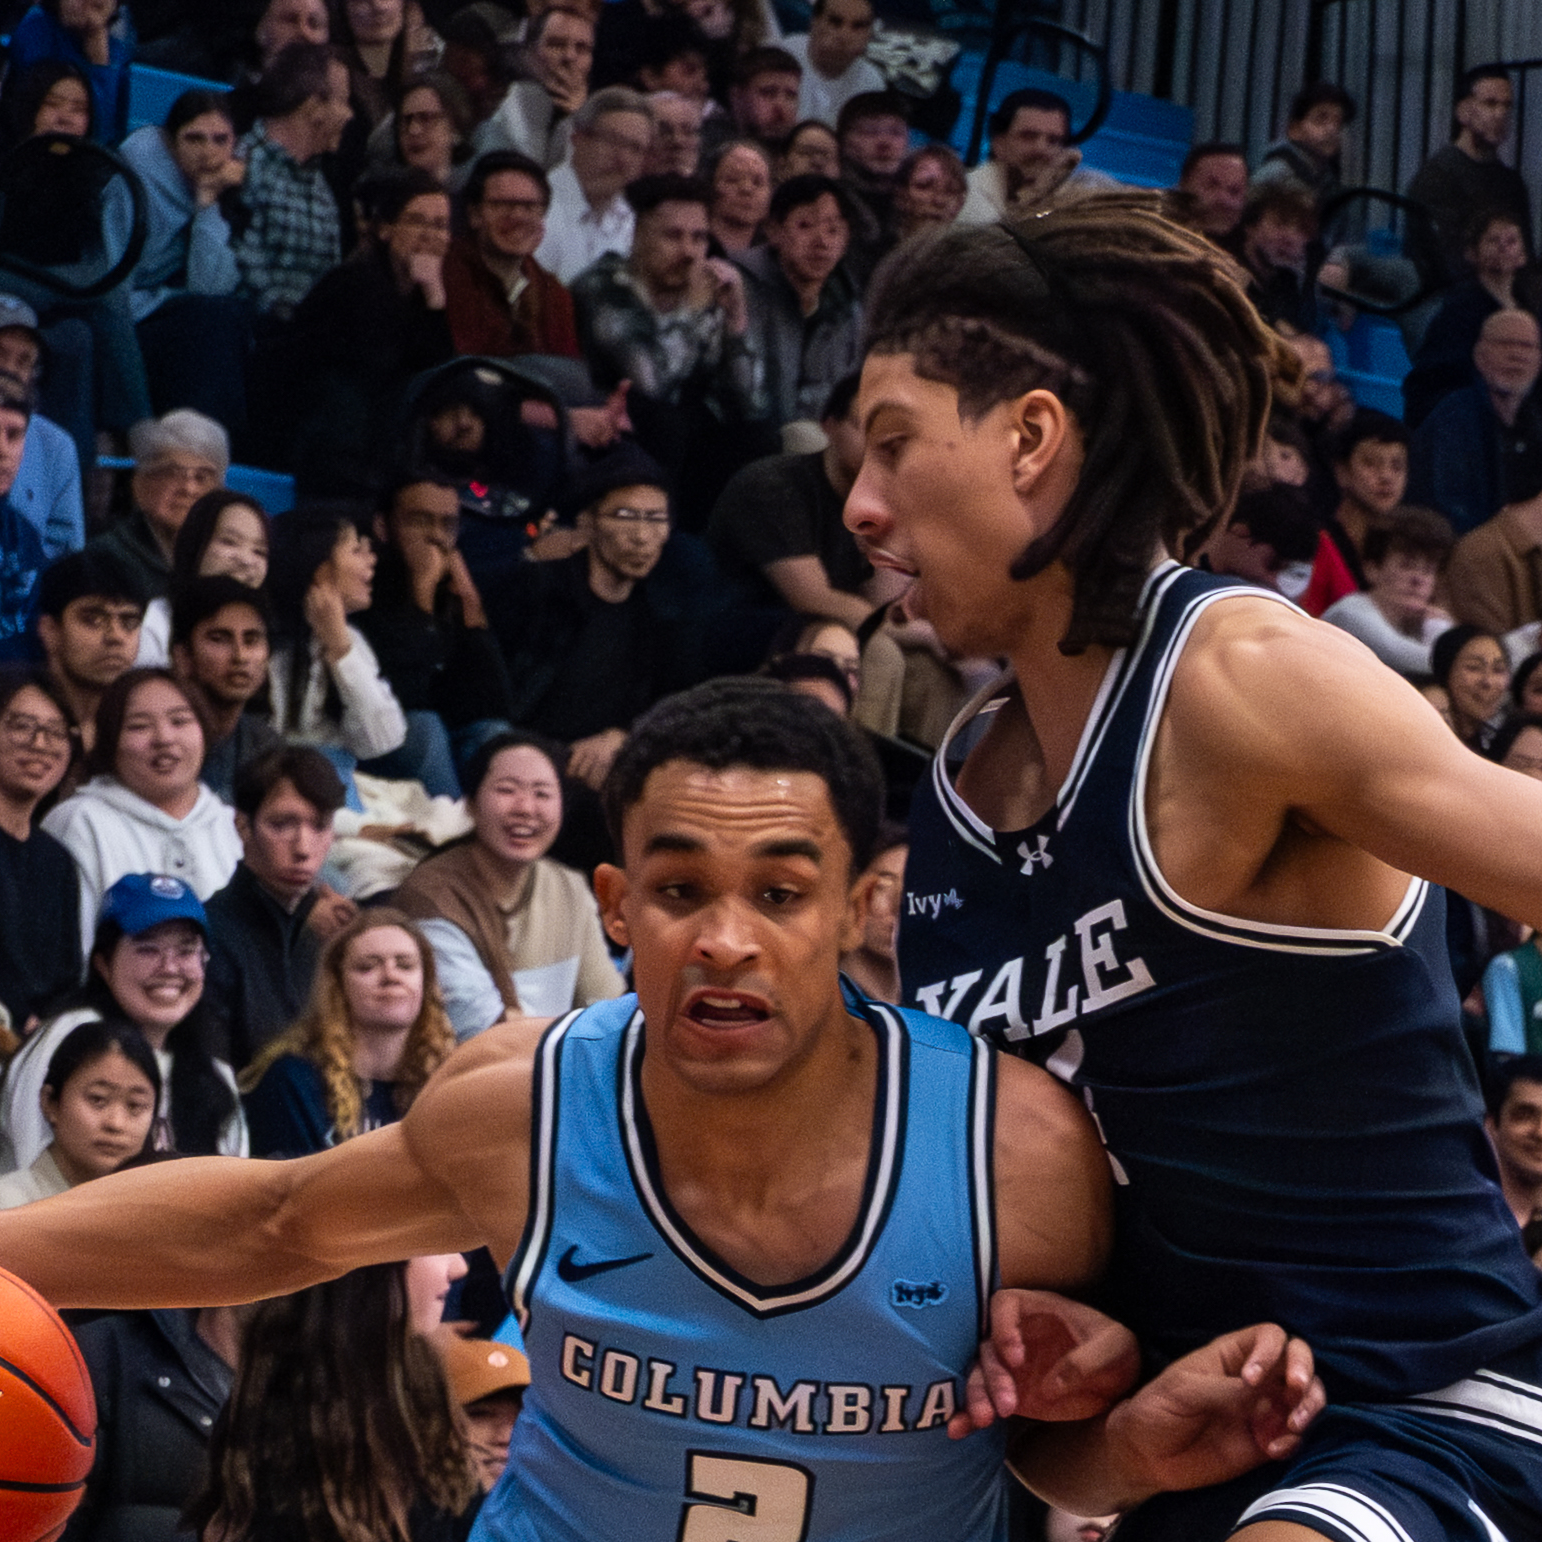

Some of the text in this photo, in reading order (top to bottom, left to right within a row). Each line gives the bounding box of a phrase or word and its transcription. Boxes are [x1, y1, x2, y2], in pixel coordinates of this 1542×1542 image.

[906, 891, 942, 920] Ivy
[915, 899, 1157, 1042] YALE
[560, 1331, 957, 1435] COLUMBIA
